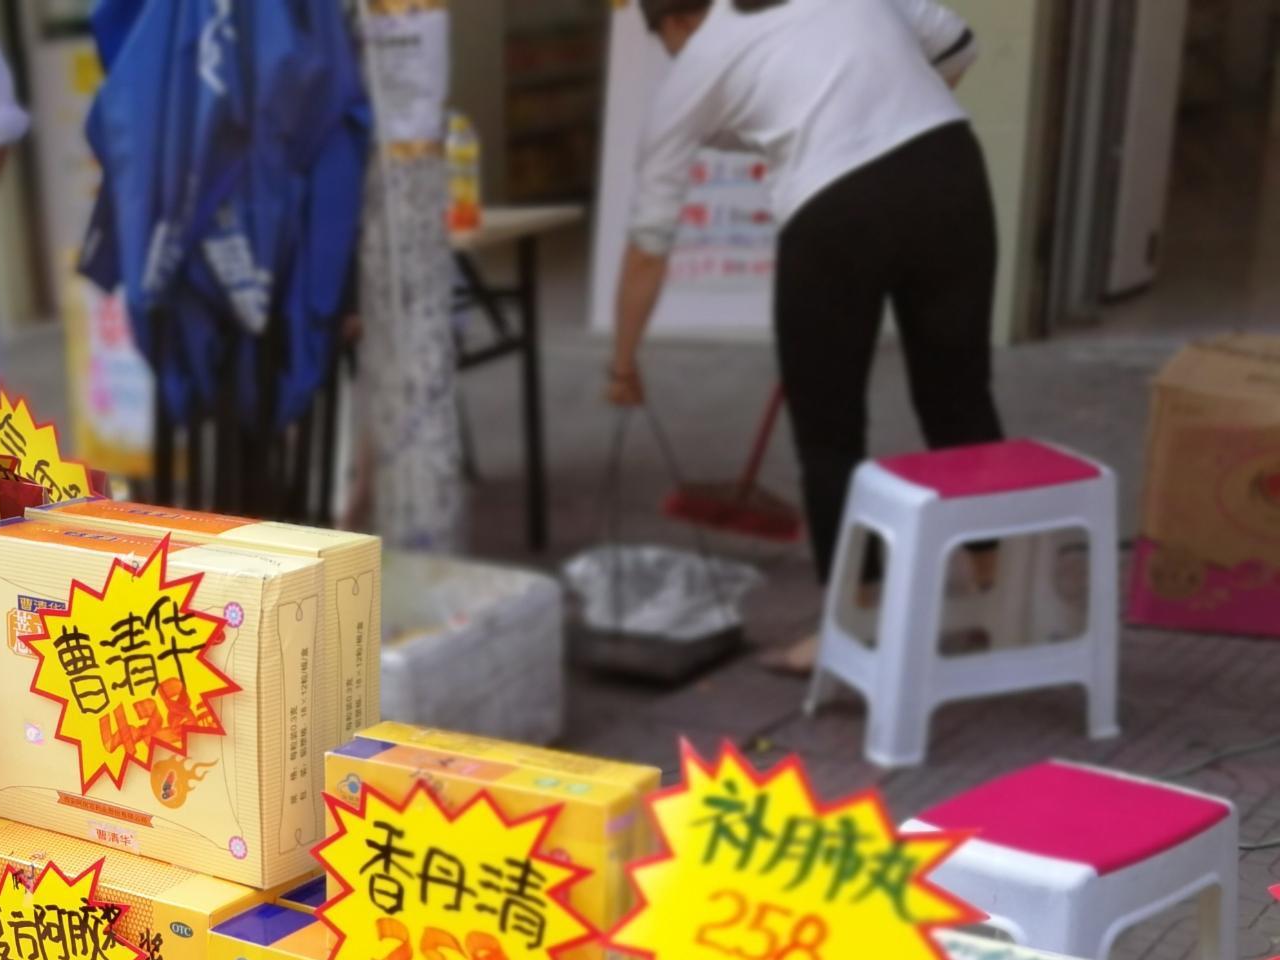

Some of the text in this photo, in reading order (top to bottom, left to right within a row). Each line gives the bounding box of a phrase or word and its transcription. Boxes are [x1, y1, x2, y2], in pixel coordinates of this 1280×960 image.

[54, 596, 206, 714] 曹清华
[360, 820, 547, 950] 香丹清
[691, 779, 920, 923] 补肺丸
[170, 922, 193, 937] OTC
